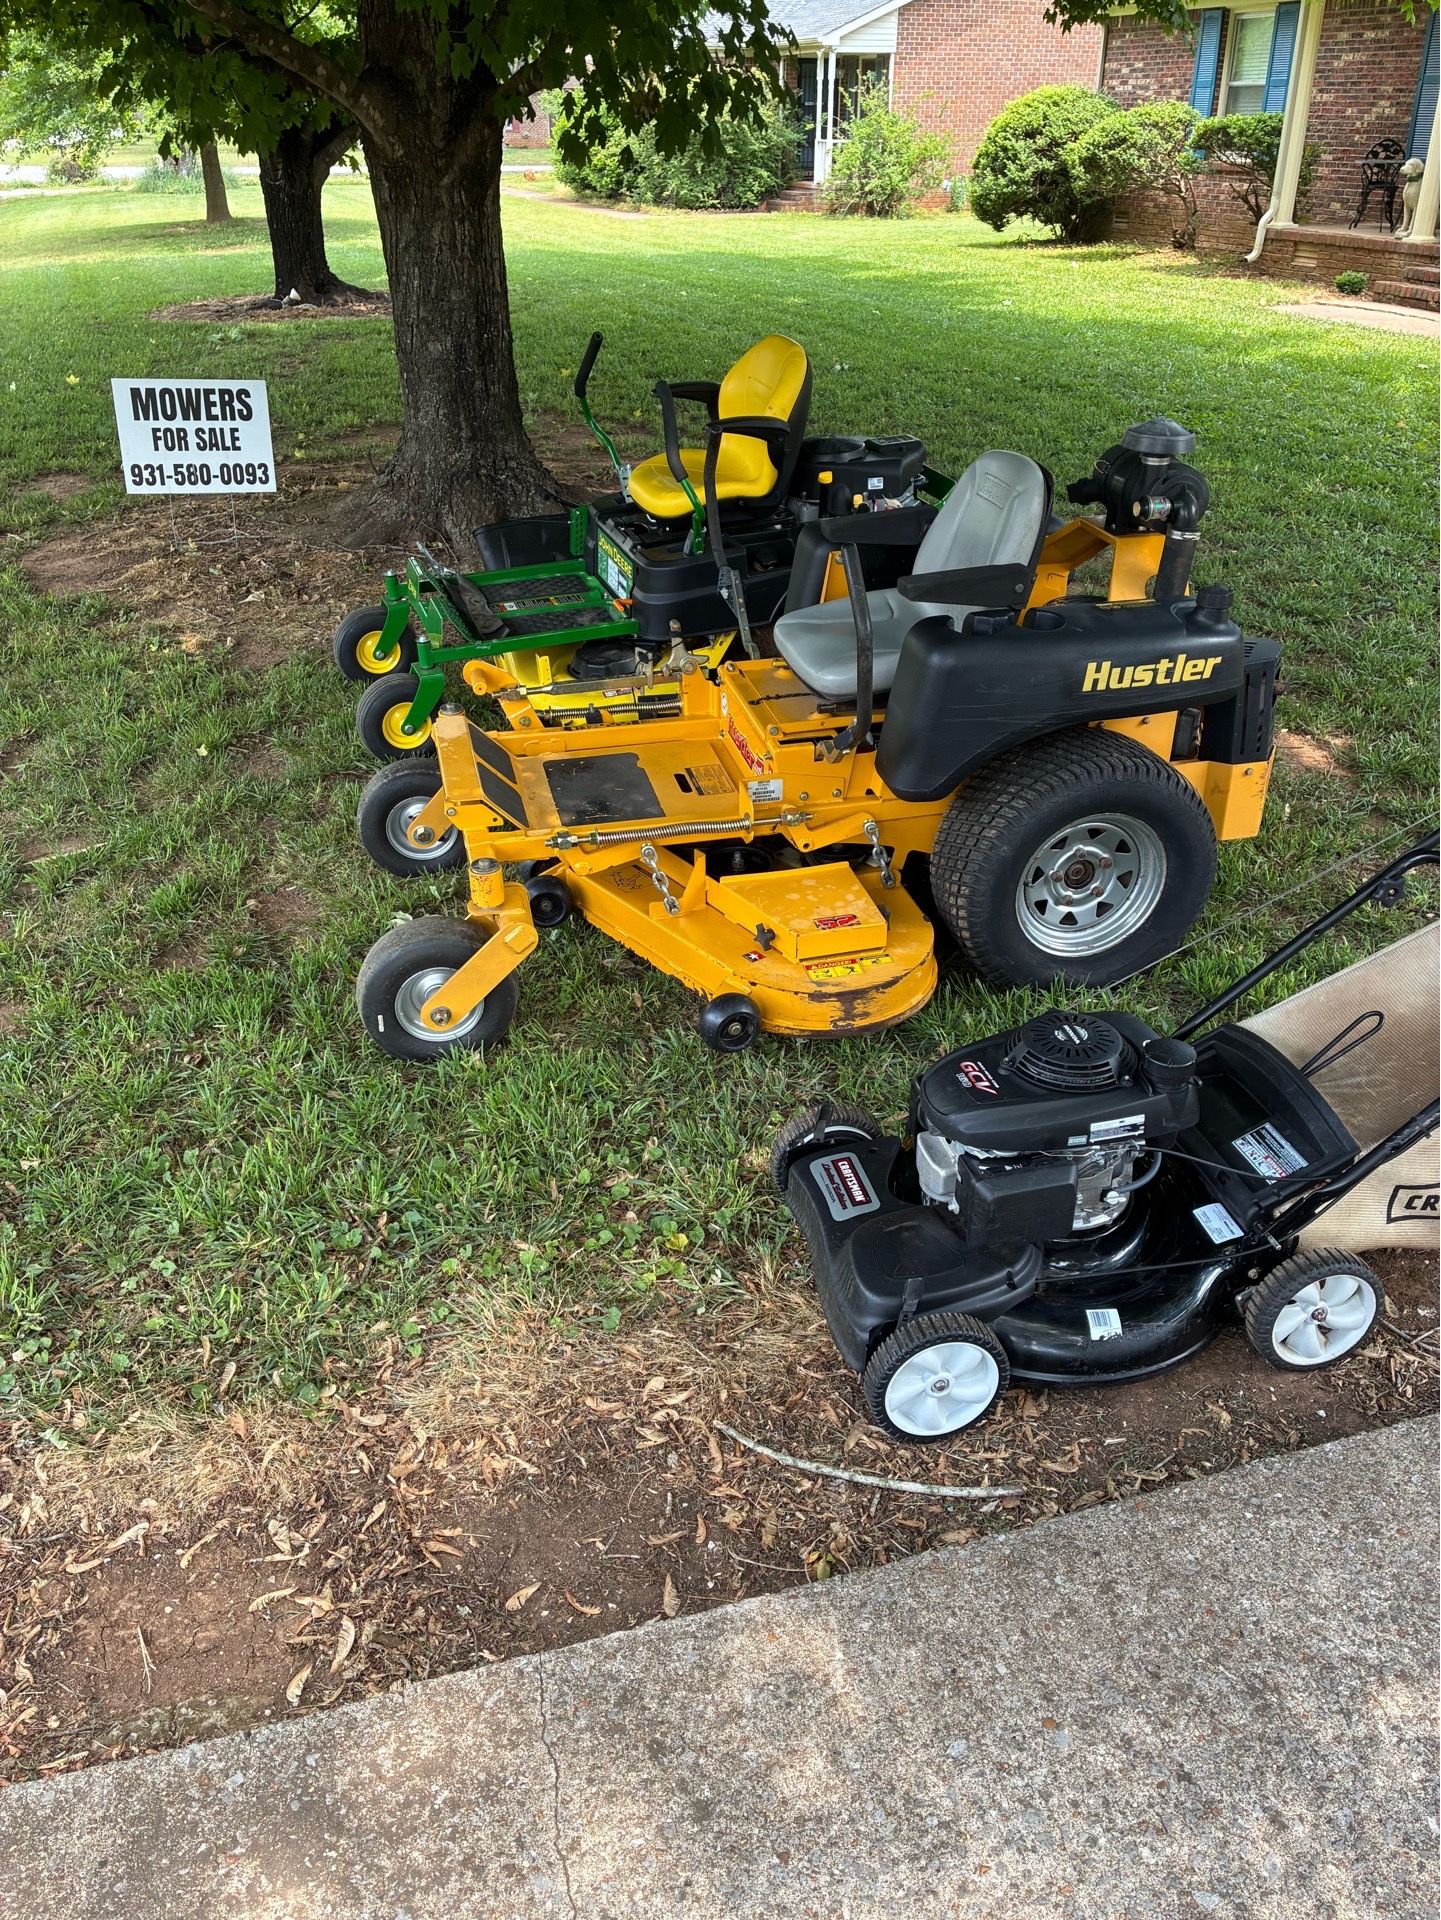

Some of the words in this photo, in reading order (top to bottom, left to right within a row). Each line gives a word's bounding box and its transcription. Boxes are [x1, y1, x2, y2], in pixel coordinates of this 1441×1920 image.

[130, 387, 253, 421] MOWERS
[152, 428, 190, 452] FOR
[195, 428, 241, 452] SALE
[131, 463, 270, 486] 931-580-0093
[613, 546, 633, 580] DEERE
[1082, 653, 1222, 692] Hustler
[959, 1061, 998, 1095] GCV
[824, 1183, 836, 1203] HONDA
[838, 1161, 865, 1202] CRAFTSMAN
